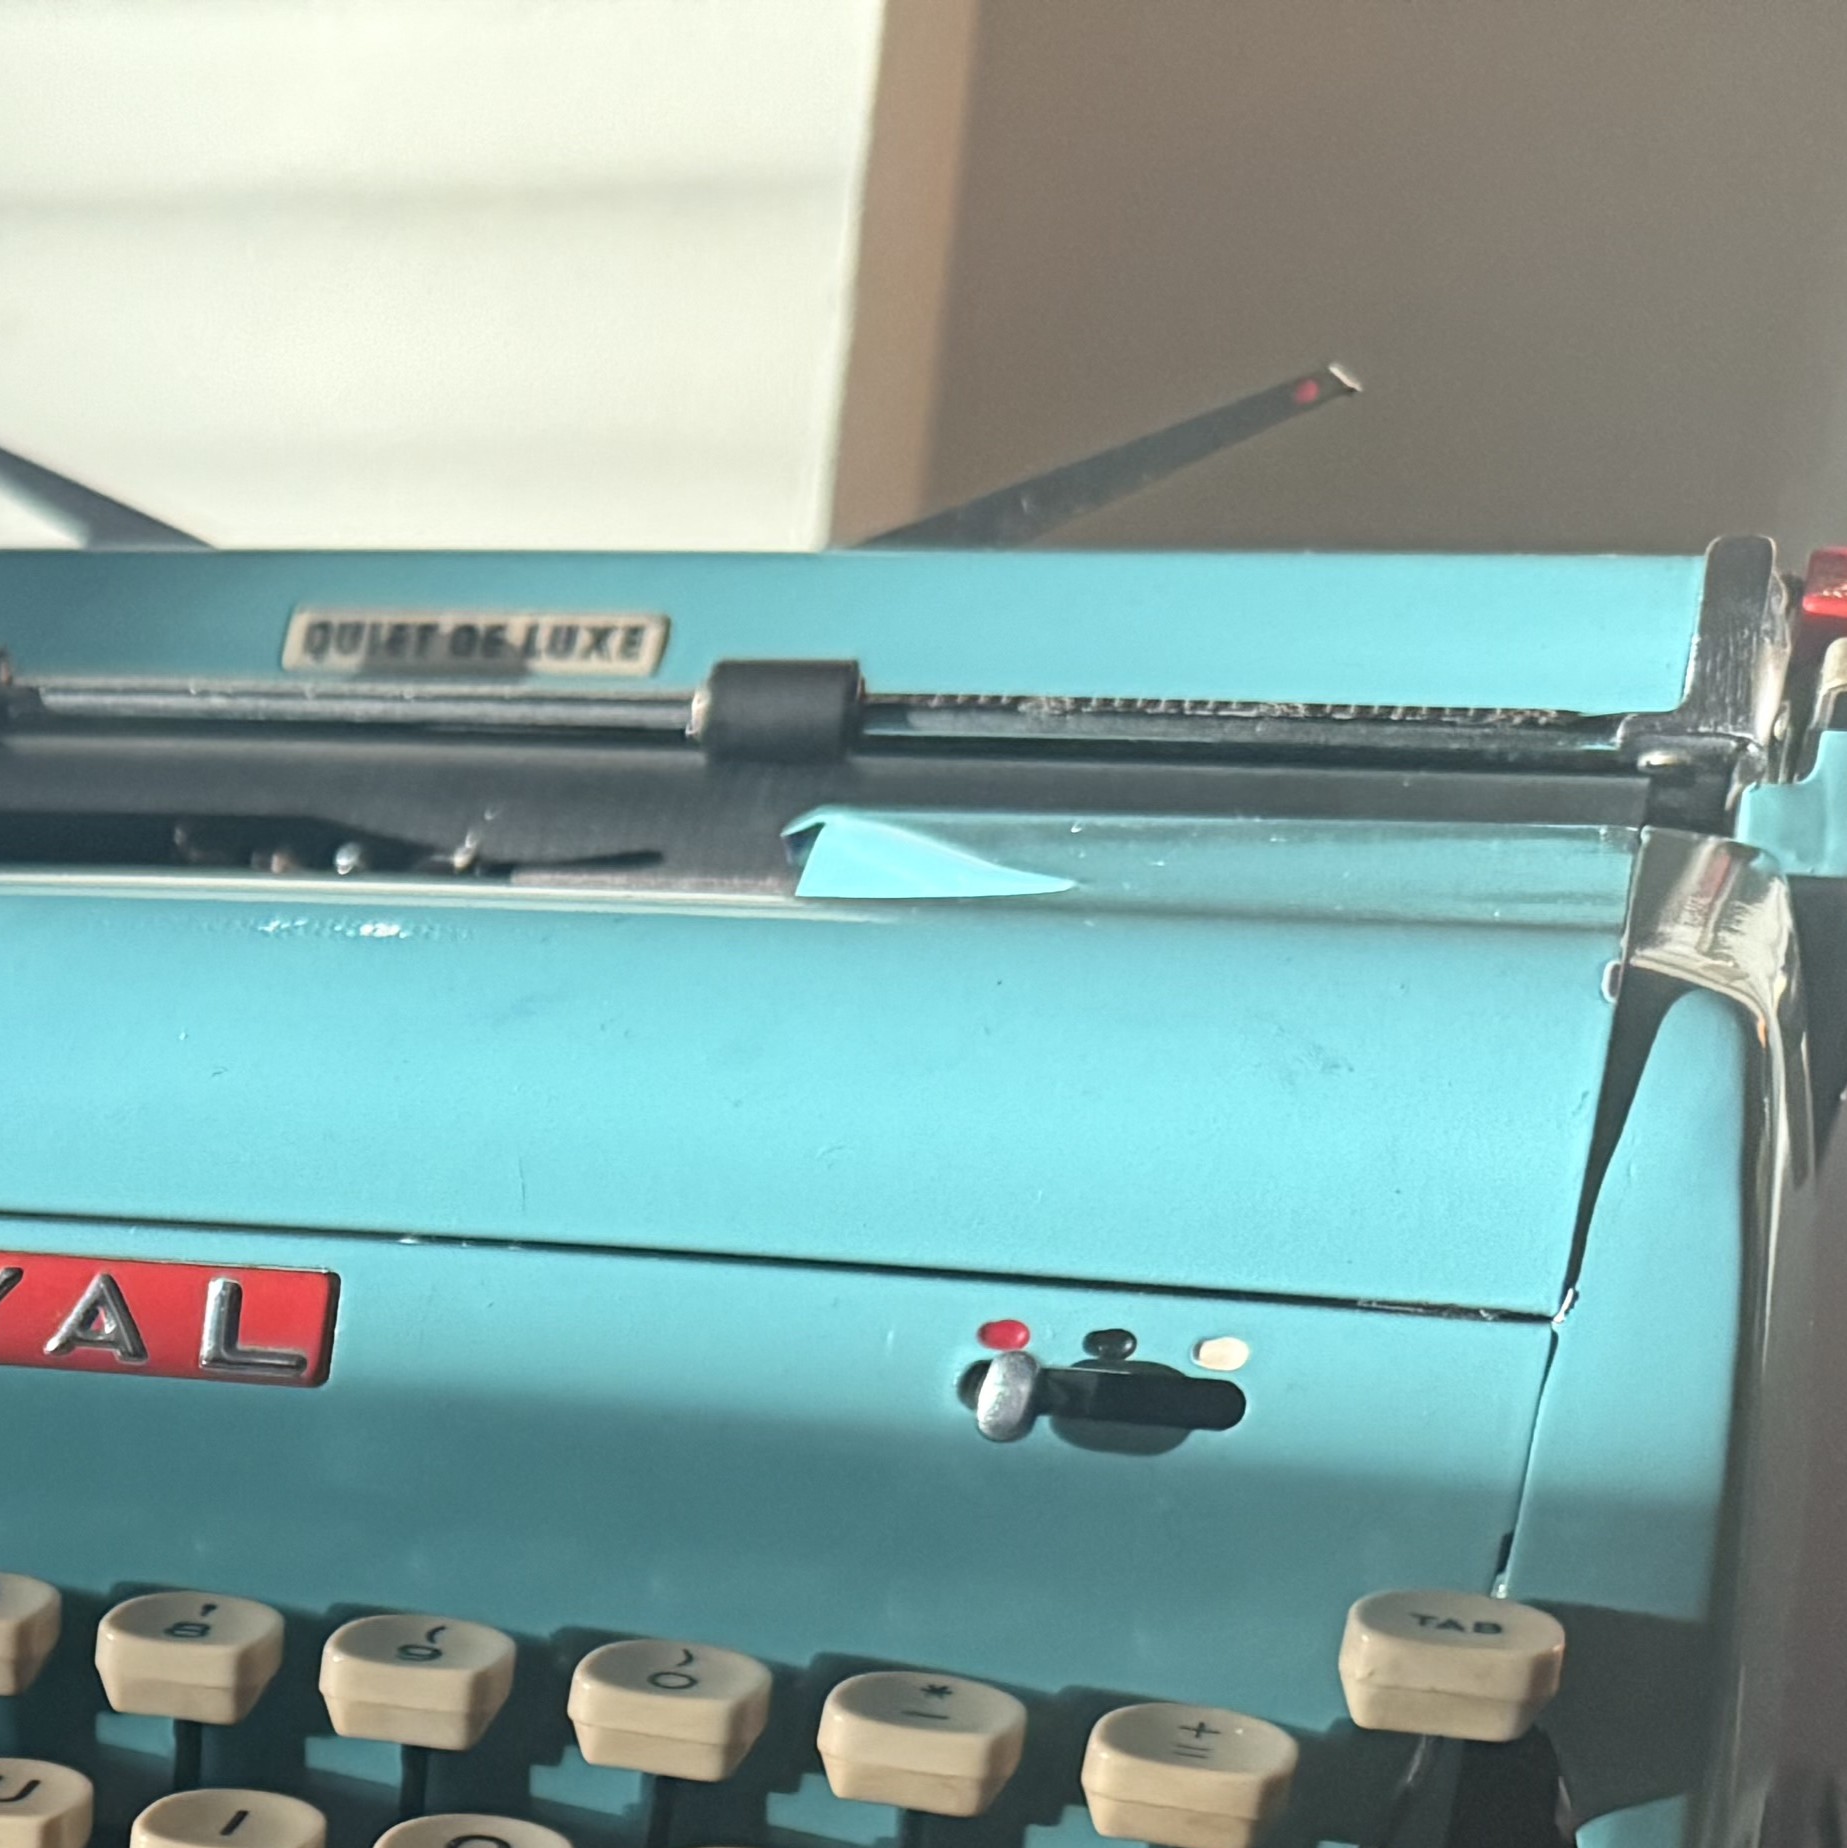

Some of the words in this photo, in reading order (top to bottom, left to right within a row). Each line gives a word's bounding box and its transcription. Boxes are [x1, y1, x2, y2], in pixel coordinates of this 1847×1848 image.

[302, 619, 442, 664] QUIET
[449, 621, 510, 661] DE
[522, 622, 647, 662] LUXE
[164, 1620, 211, 1639] 8
[1408, 1611, 1505, 1636] TAB
[1177, 1720, 1223, 1739] +
[219, 1809, 250, 1836] I
